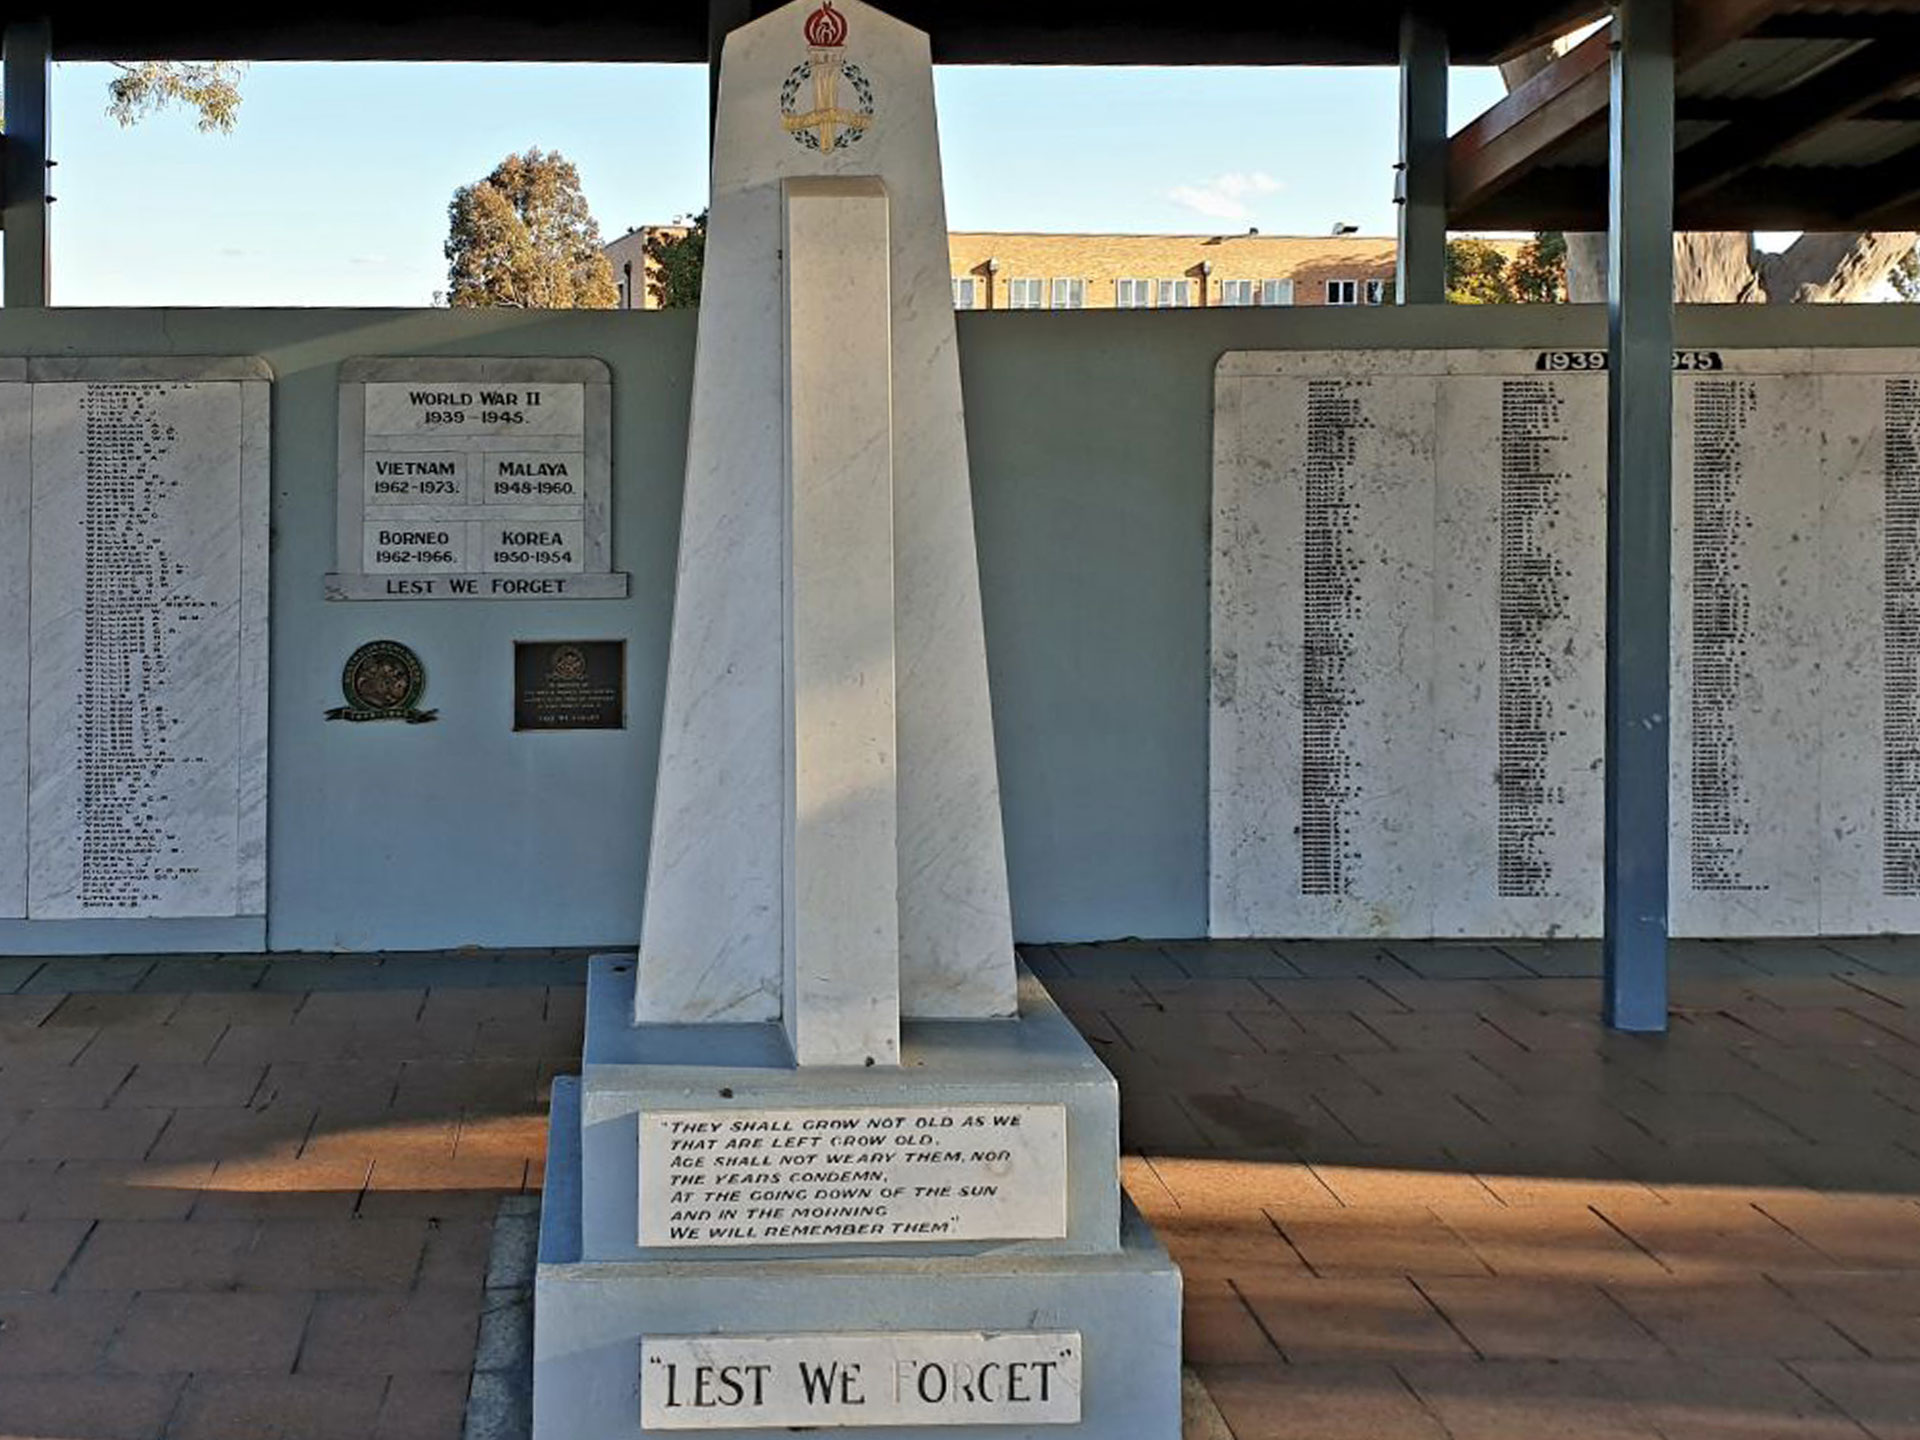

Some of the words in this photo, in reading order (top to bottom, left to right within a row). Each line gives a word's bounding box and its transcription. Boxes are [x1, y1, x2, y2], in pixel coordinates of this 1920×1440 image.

[1545, 352, 1604, 370] 1939
[409, 391, 473, 407] WORLD
[480, 391, 518, 407] WAR
[525, 391, 541, 407] II
[375, 460, 455, 476] VIETNAM
[498, 461, 568, 477] MALAYA
[379, 530, 450, 545] BORNEO
[502, 531, 563, 546] KOREA
[386, 579, 436, 594] LEST
[450, 579, 478, 594] WE
[492, 579, 567, 594] FORGET
[729, 1120, 794, 1132] SHALL
[802, 1119, 861, 1131] GROW
[867, 1117, 907, 1129] NOT
[915, 1116, 954, 1128] OLD
[962, 1115, 986, 1128] AS
[993, 1115, 1023, 1127] WE
[670, 1139, 718, 1151] THAT
[725, 1137, 764, 1149] ARE
[772, 1136, 823, 1148] LEFT
[830, 1135, 887, 1147] GROW
[670, 1155, 706, 1168] AGE
[713, 1155, 773, 1167] SHALL
[779, 1153, 819, 1165] NOT
[826, 1152, 897, 1164] WEARY
[970, 1150, 1011, 1162] NOR
[670, 1174, 706, 1186] THE
[715, 1172, 783, 1185] YEARS
[670, 1191, 695, 1204] AT
[704, 1190, 742, 1203] THE
[750, 1189, 809, 1201] GOING
[814, 1187, 872, 1200] DOWN
[879, 1186, 906, 1199] OF
[914, 1186, 952, 1198] THE
[958, 1185, 999, 1197] SUN
[670, 1209, 712, 1222] AND
[718, 1208, 739, 1220] IN
[746, 1207, 785, 1220] THE
[791, 1205, 889, 1219] MORNING
[669, 1226, 701, 1239] WE
[709, 1226, 758, 1238] WILL
[764, 1223, 885, 1237] REMEMBER
[799, 1361, 866, 1406] WE
